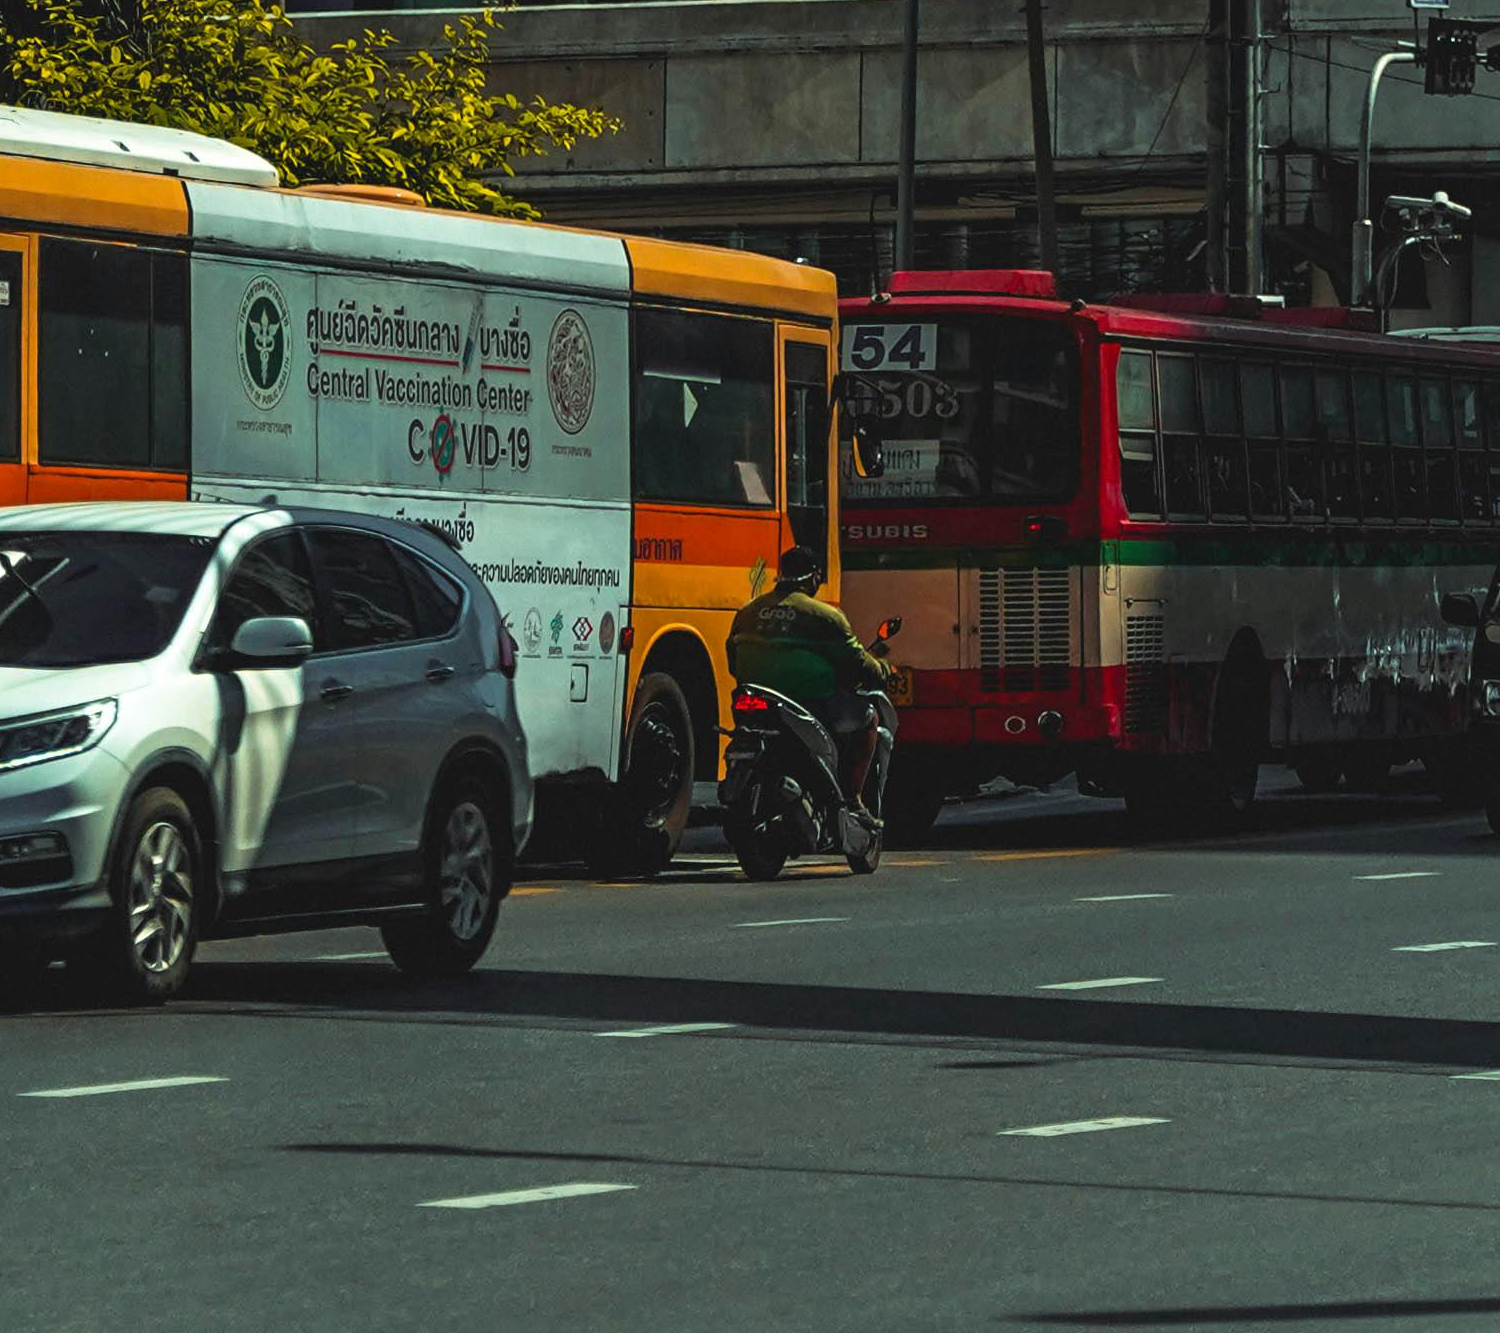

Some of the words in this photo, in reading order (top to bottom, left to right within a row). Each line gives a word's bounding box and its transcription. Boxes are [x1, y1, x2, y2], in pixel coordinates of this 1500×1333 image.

[306, 299, 460, 357] ศูนย์ฉีดวัคซีนกลาง
[480, 306, 531, 360] บางซื่อ
[851, 325, 926, 369] 54
[307, 361, 370, 401] Central
[374, 366, 472, 410] Vaccination
[476, 377, 531, 413] Center
[469, 557, 621, 594] ละความปลอดภัยของคนไทยทุกคน
